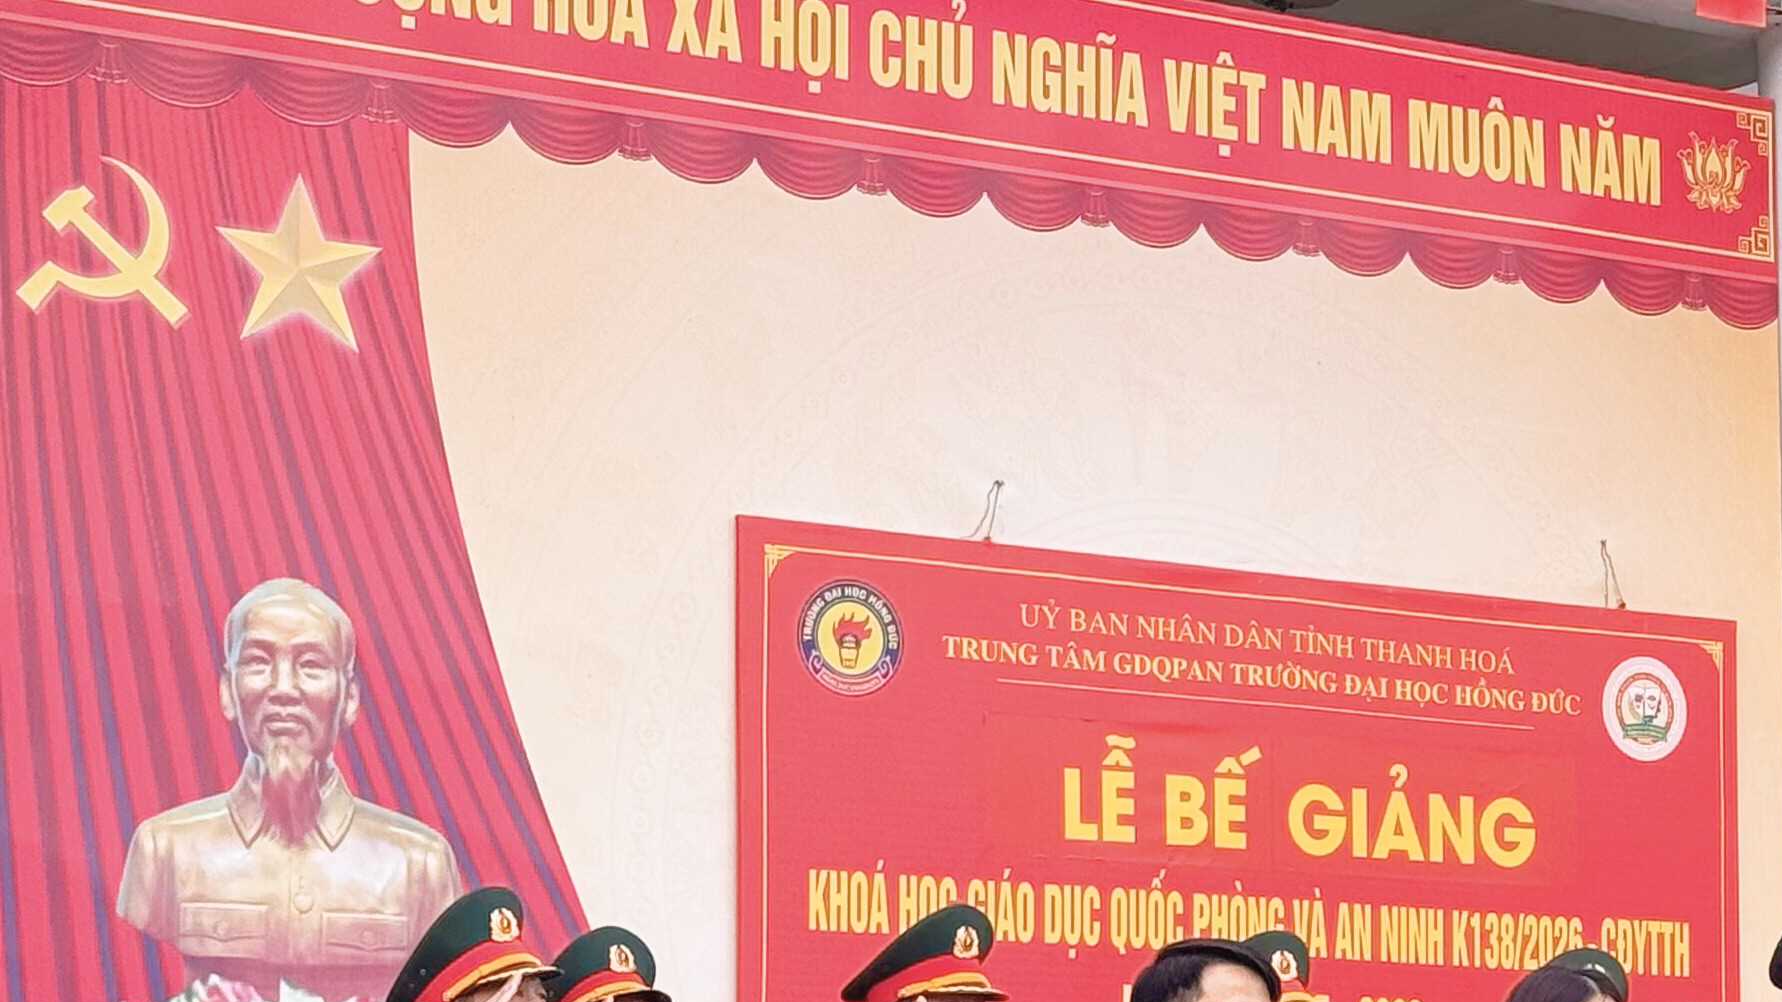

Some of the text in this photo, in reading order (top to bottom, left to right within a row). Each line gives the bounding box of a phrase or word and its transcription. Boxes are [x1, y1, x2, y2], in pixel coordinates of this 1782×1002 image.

[868, 0, 975, 100] CHỦ
[992, 30, 1149, 128] NGHĨA
[1163, 51, 1268, 157] VIỆT
[1281, 77, 1392, 165] NAM
[1407, 96, 1546, 189] MUÔN
[1559, 113, 1662, 206] NĂM
[942, 635, 1040, 666] TRUNG
[1045, 641, 1107, 673] TÂM
[1112, 651, 1225, 684] GDQPAN
[1230, 660, 1338, 694] TRƯỜNG
[1343, 673, 1389, 702] ĐẠI
[1394, 679, 1449, 708] HỌC
[1069, 608, 1130, 637] BAN
[1136, 613, 1217, 648] NHÂN
[1224, 619, 1284, 651] DÂN
[1289, 625, 1355, 658] TỈNH
[1360, 637, 1454, 670] THANH
[1458, 646, 1516, 675] HOÁ
[1063, 734, 1537, 868] LỄ BẾ GIẢNG
[808, 859, 891, 935] KHOÁ
[1044, 882, 1101, 960] DỤC
[1109, 868, 1185, 956] QUỐC
[1192, 879, 1286, 943] PHÒNG
[1292, 886, 1329, 959] VÀ
[1334, 901, 1373, 961] AN
[1379, 903, 1445, 967] NINH
